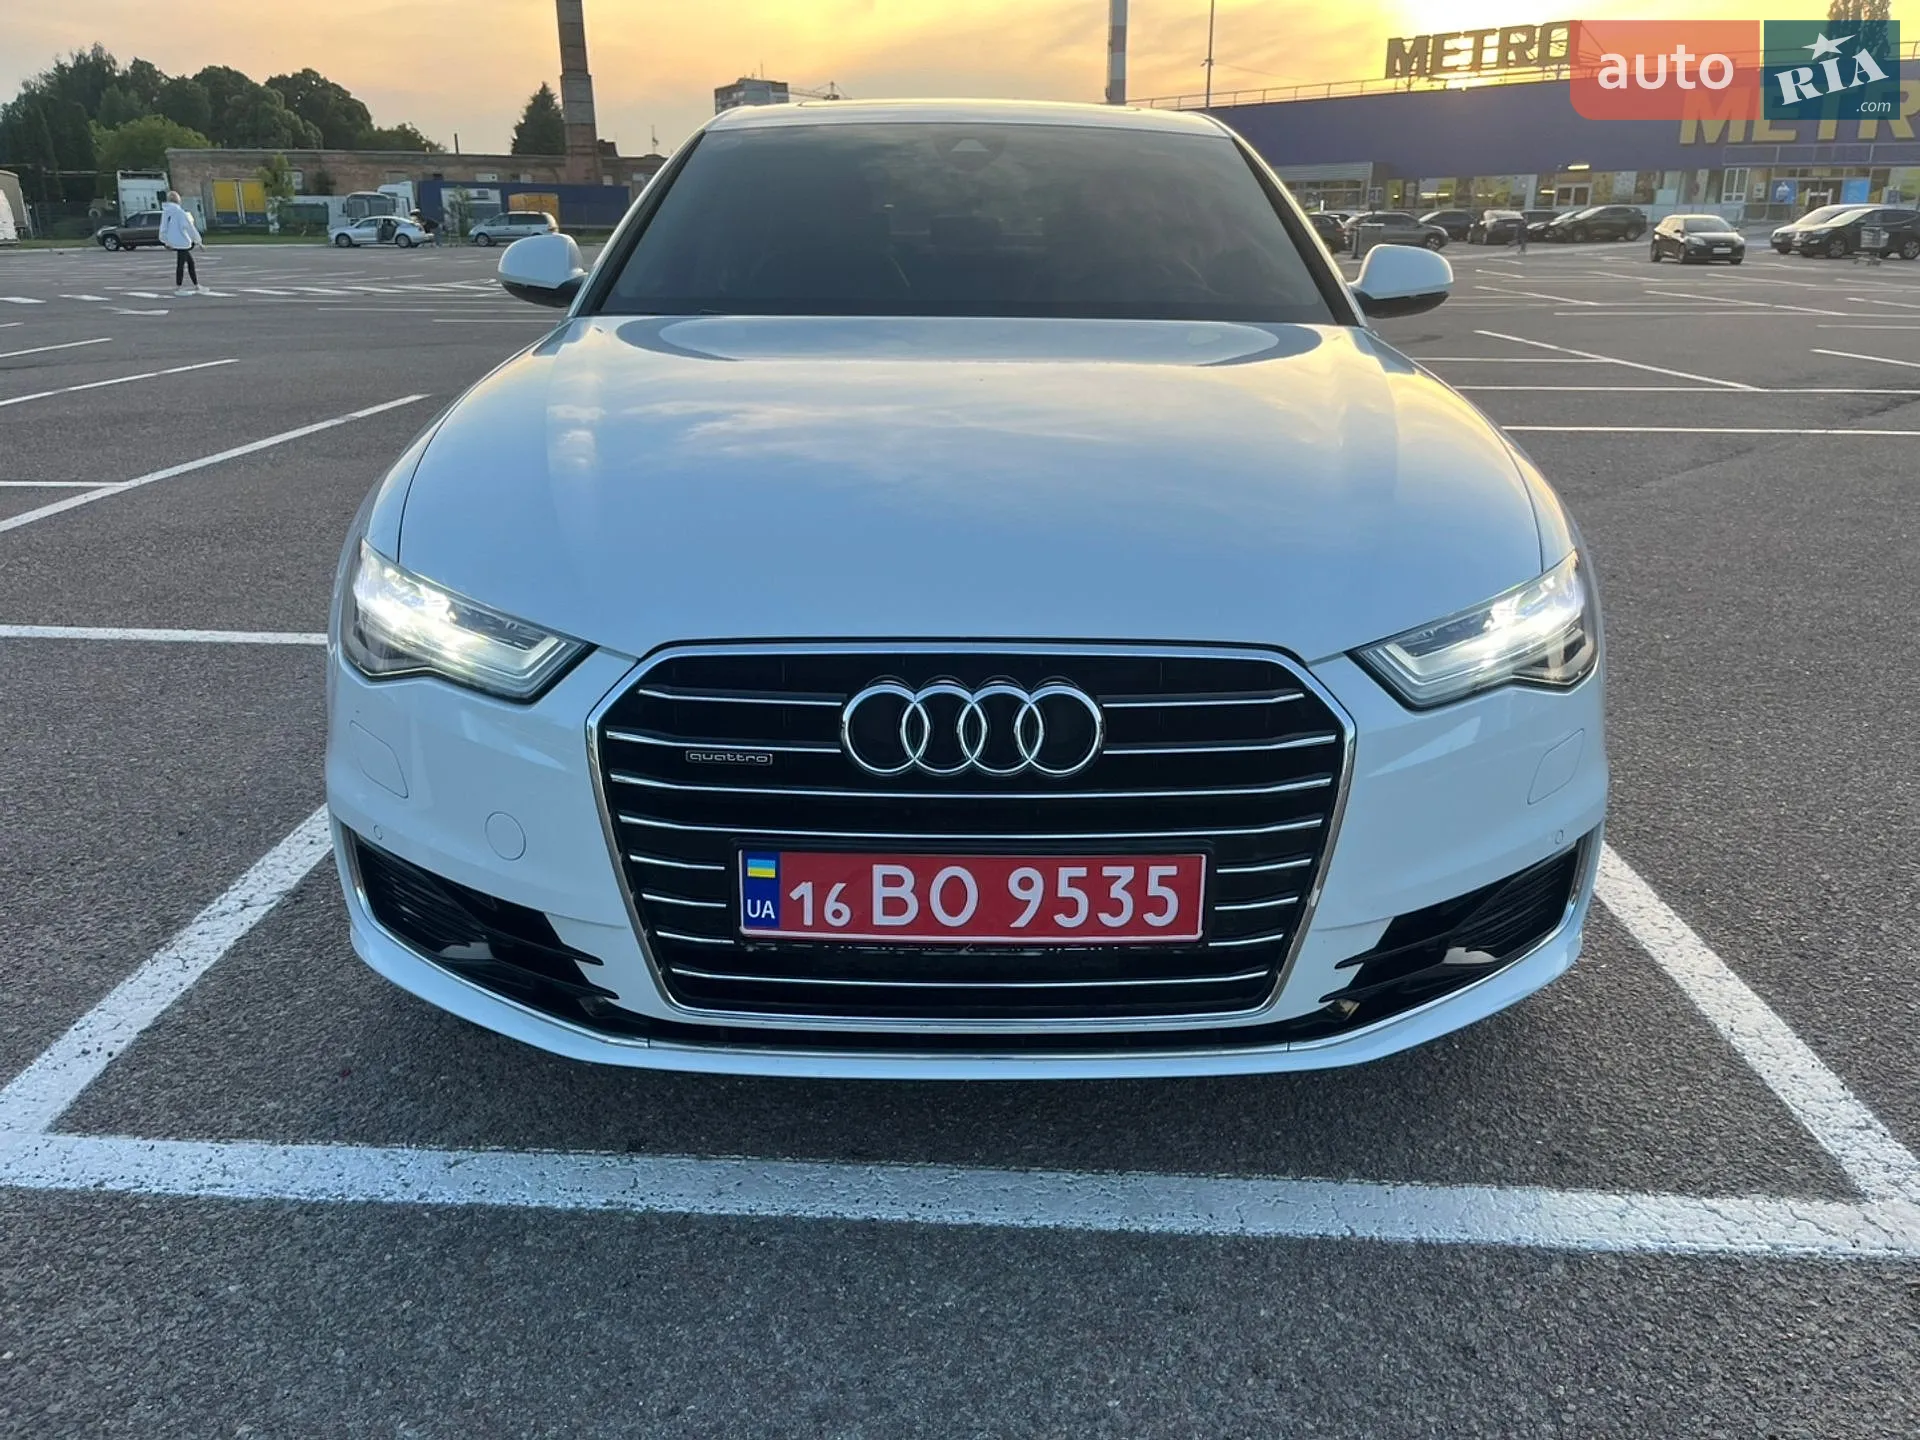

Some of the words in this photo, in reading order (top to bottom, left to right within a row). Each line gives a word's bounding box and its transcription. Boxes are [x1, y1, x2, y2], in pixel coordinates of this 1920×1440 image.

[1385, 20, 1581, 79] METRO
[689, 753, 769, 763] quattro
[747, 899, 776, 919] UA
[789, 881, 851, 927] 16
[872, 864, 978, 927] BO
[1007, 865, 1179, 928] 9535
